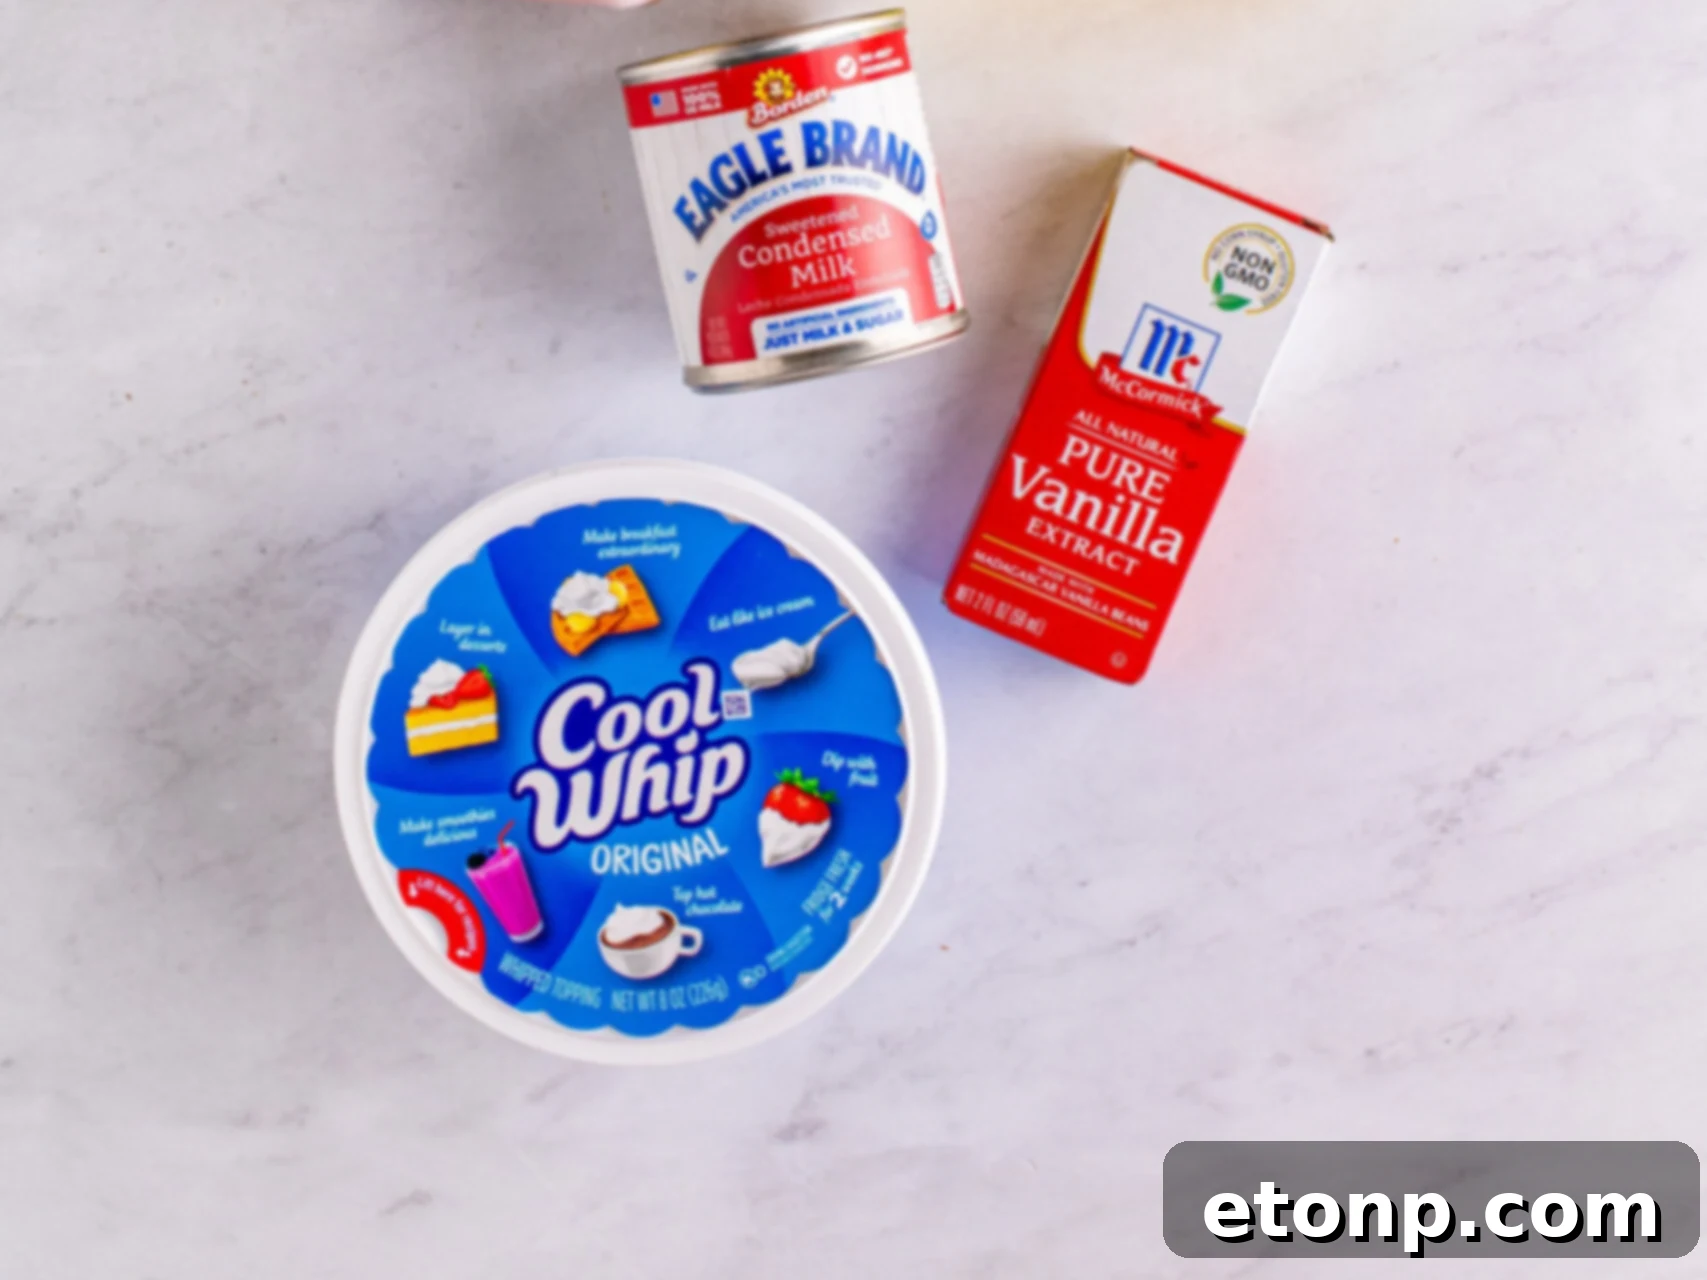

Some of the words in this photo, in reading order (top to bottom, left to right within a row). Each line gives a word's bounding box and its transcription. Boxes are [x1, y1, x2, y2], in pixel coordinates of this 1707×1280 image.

[672, 128, 793, 245] EAGLE
[800, 118, 926, 196] BRAND
[791, 173, 826, 191] MOST
[737, 214, 892, 269] Condensed
[763, 205, 860, 239] Sweetened
[789, 253, 857, 290] Milk
[1223, 263, 1270, 292] GMO
[1231, 245, 1277, 275] NON
[764, 332, 798, 351] JUST
[801, 324, 839, 343] MILK
[856, 308, 904, 331] SUGAR
[1099, 364, 1205, 417] McCormick
[1073, 409, 1104, 431] ALL
[1105, 422, 1179, 462] NATURAL
[1057, 433, 1172, 505] PURE
[1011, 452, 1185, 565] Vanilla
[582, 528, 617, 545] Make
[620, 523, 677, 542] breakfast
[597, 542, 681, 560] extraordinary
[1026, 516, 1140, 577] EXTRACT
[972, 549, 1058, 593] MADAGASCAR
[1060, 587, 1110, 616] VANILLA
[709, 615, 730, 633] Eat
[732, 607, 755, 627] like
[757, 605, 775, 621] ice
[537, 662, 721, 770] Cool
[821, 749, 845, 772] Dip
[515, 728, 746, 850] Whip
[398, 817, 433, 835] Make
[590, 827, 730, 876] ORIGINAL
[672, 886, 694, 903] Top
[696, 885, 717, 901] hot
[552, 976, 602, 1010] TOPPING
[610, 988, 635, 1013] NET
[637, 989, 656, 1012] WT
